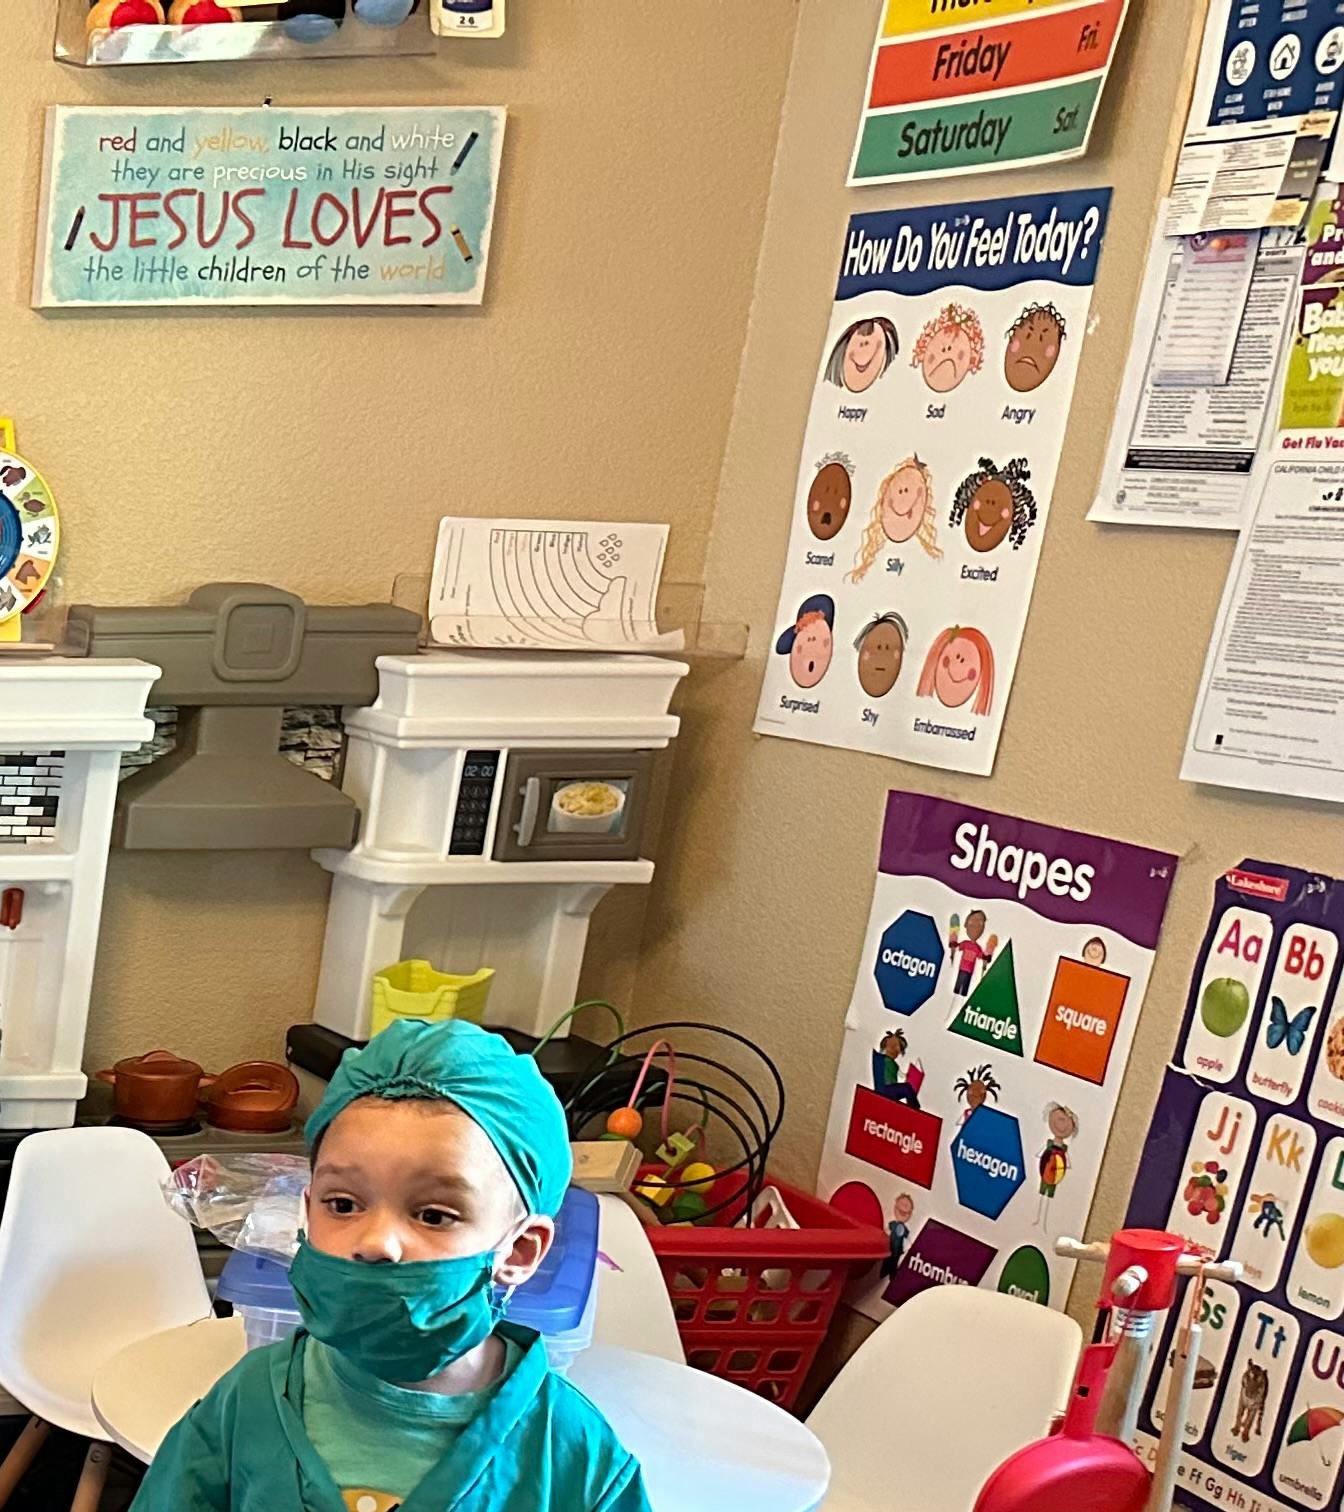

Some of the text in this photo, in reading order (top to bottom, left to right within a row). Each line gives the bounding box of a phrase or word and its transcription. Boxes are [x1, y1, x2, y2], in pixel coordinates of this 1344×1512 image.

[933, 36, 1011, 81] Friday
[100, 127, 137, 153] red
[146, 127, 185, 153] and
[279, 127, 337, 152] black
[346, 125, 385, 151] and
[391, 124, 455, 151] white
[898, 110, 1012, 157] Saturday
[112, 157, 438, 188] they are precious in His sight
[90, 186, 453, 252] JESUS LOVES
[844, 207, 1099, 276] How Do You Feel Today?
[84, 254, 445, 283] the little children of the world
[838, 406, 867, 422] Happy
[926, 404, 946, 418] Sad
[1001, 406, 1036, 424] Angry
[805, 552, 834, 566] Scared
[886, 558, 904, 576] Silly
[961, 565, 999, 581] Excited
[780, 695, 820, 713] Surprised
[862, 709, 879, 726] Shy
[914, 718, 976, 741] Embarrassed
[949, 822, 1096, 901] Shapes
[1218, 919, 1262, 963] Aa
[883, 949, 935, 977] octagon
[1285, 936, 1324, 980] Bb
[963, 1005, 1018, 1040] triangle
[1056, 1006, 1106, 1035] square
[1197, 1057, 1223, 1071] apple
[1251, 1073, 1293, 1098] butterfly
[864, 1119, 922, 1154] rectangle
[1208, 1107, 1242, 1155] Jj
[958, 1139, 1017, 1180] hexagon
[1266, 1123, 1304, 1172] Kk
[1298, 1286, 1330, 1308] lemon
[1256, 1313, 1286, 1358] Tt
[1189, 1468, 1223, 1499] Ff Gg
[1279, 1473, 1323, 1501] umbrella
